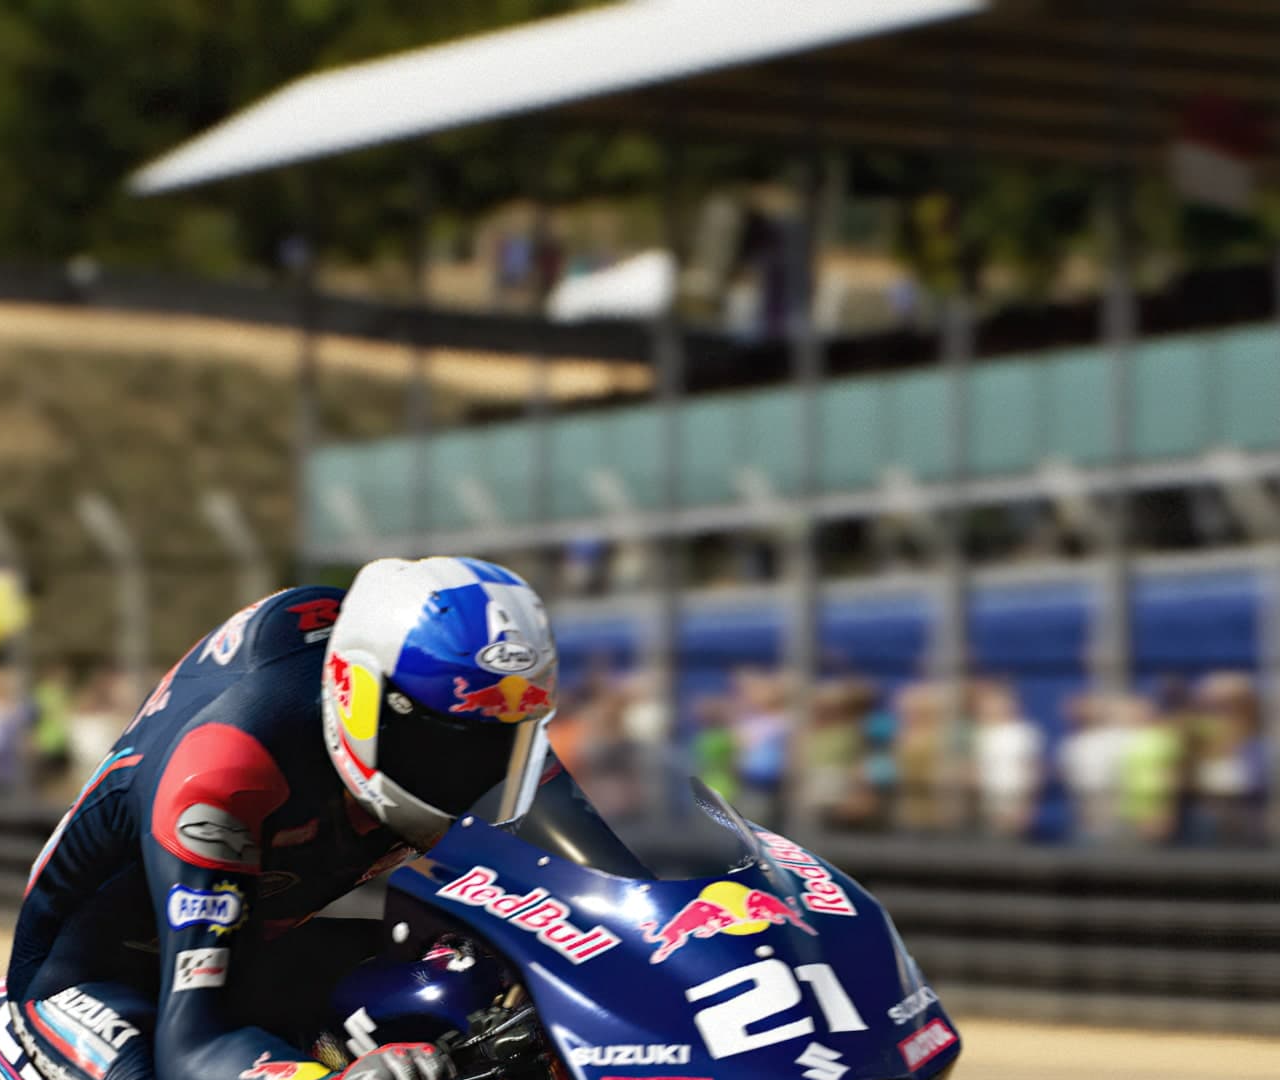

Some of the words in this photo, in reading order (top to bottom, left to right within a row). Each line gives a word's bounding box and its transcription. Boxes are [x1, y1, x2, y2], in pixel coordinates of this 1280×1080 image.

[177, 896, 229, 919] AFAM
[435, 866, 551, 919] Red
[507, 896, 622, 965] Bull
[685, 957, 870, 1060] 21
[570, 1044, 692, 1067] SUZUKI
